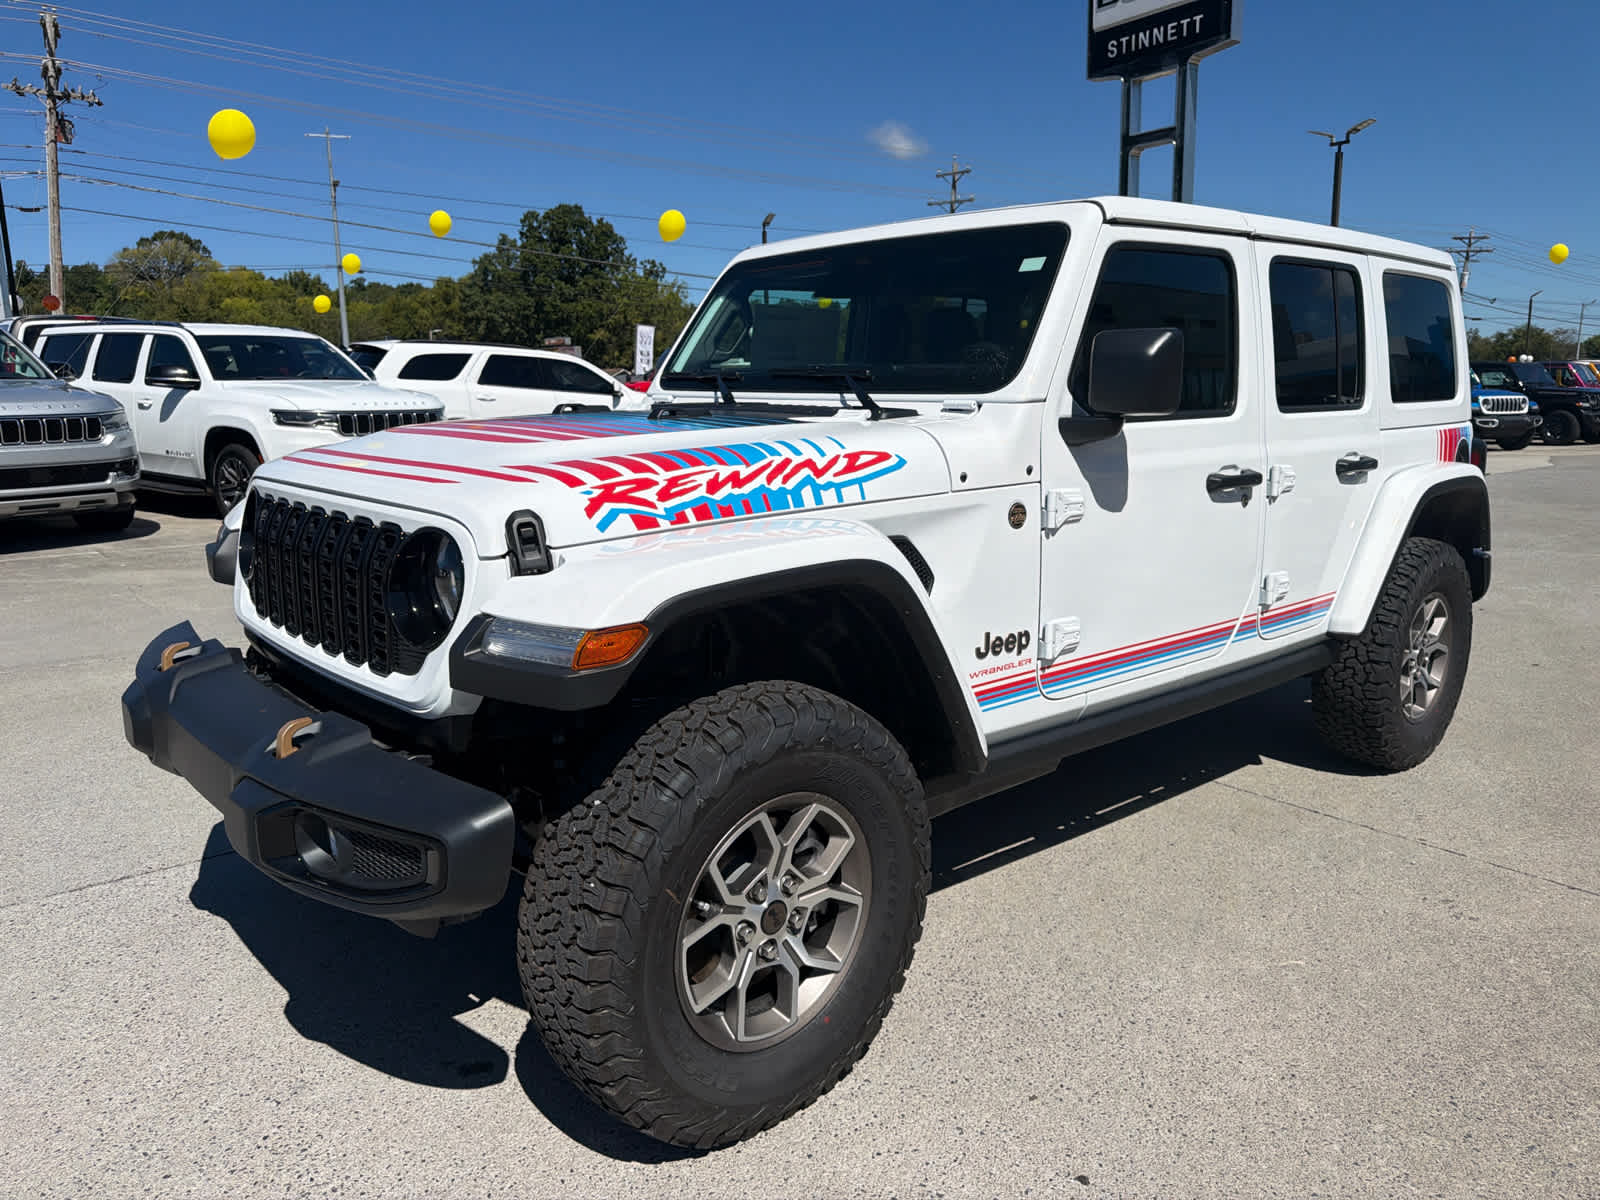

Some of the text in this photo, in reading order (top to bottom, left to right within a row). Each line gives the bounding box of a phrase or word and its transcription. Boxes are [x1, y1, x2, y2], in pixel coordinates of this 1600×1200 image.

[1107, 14, 1205, 58] STINNETT
[584, 450, 893, 519] REWIND
[975, 629, 1031, 660] Jeep
[969, 657, 1033, 679] WRANGLER
